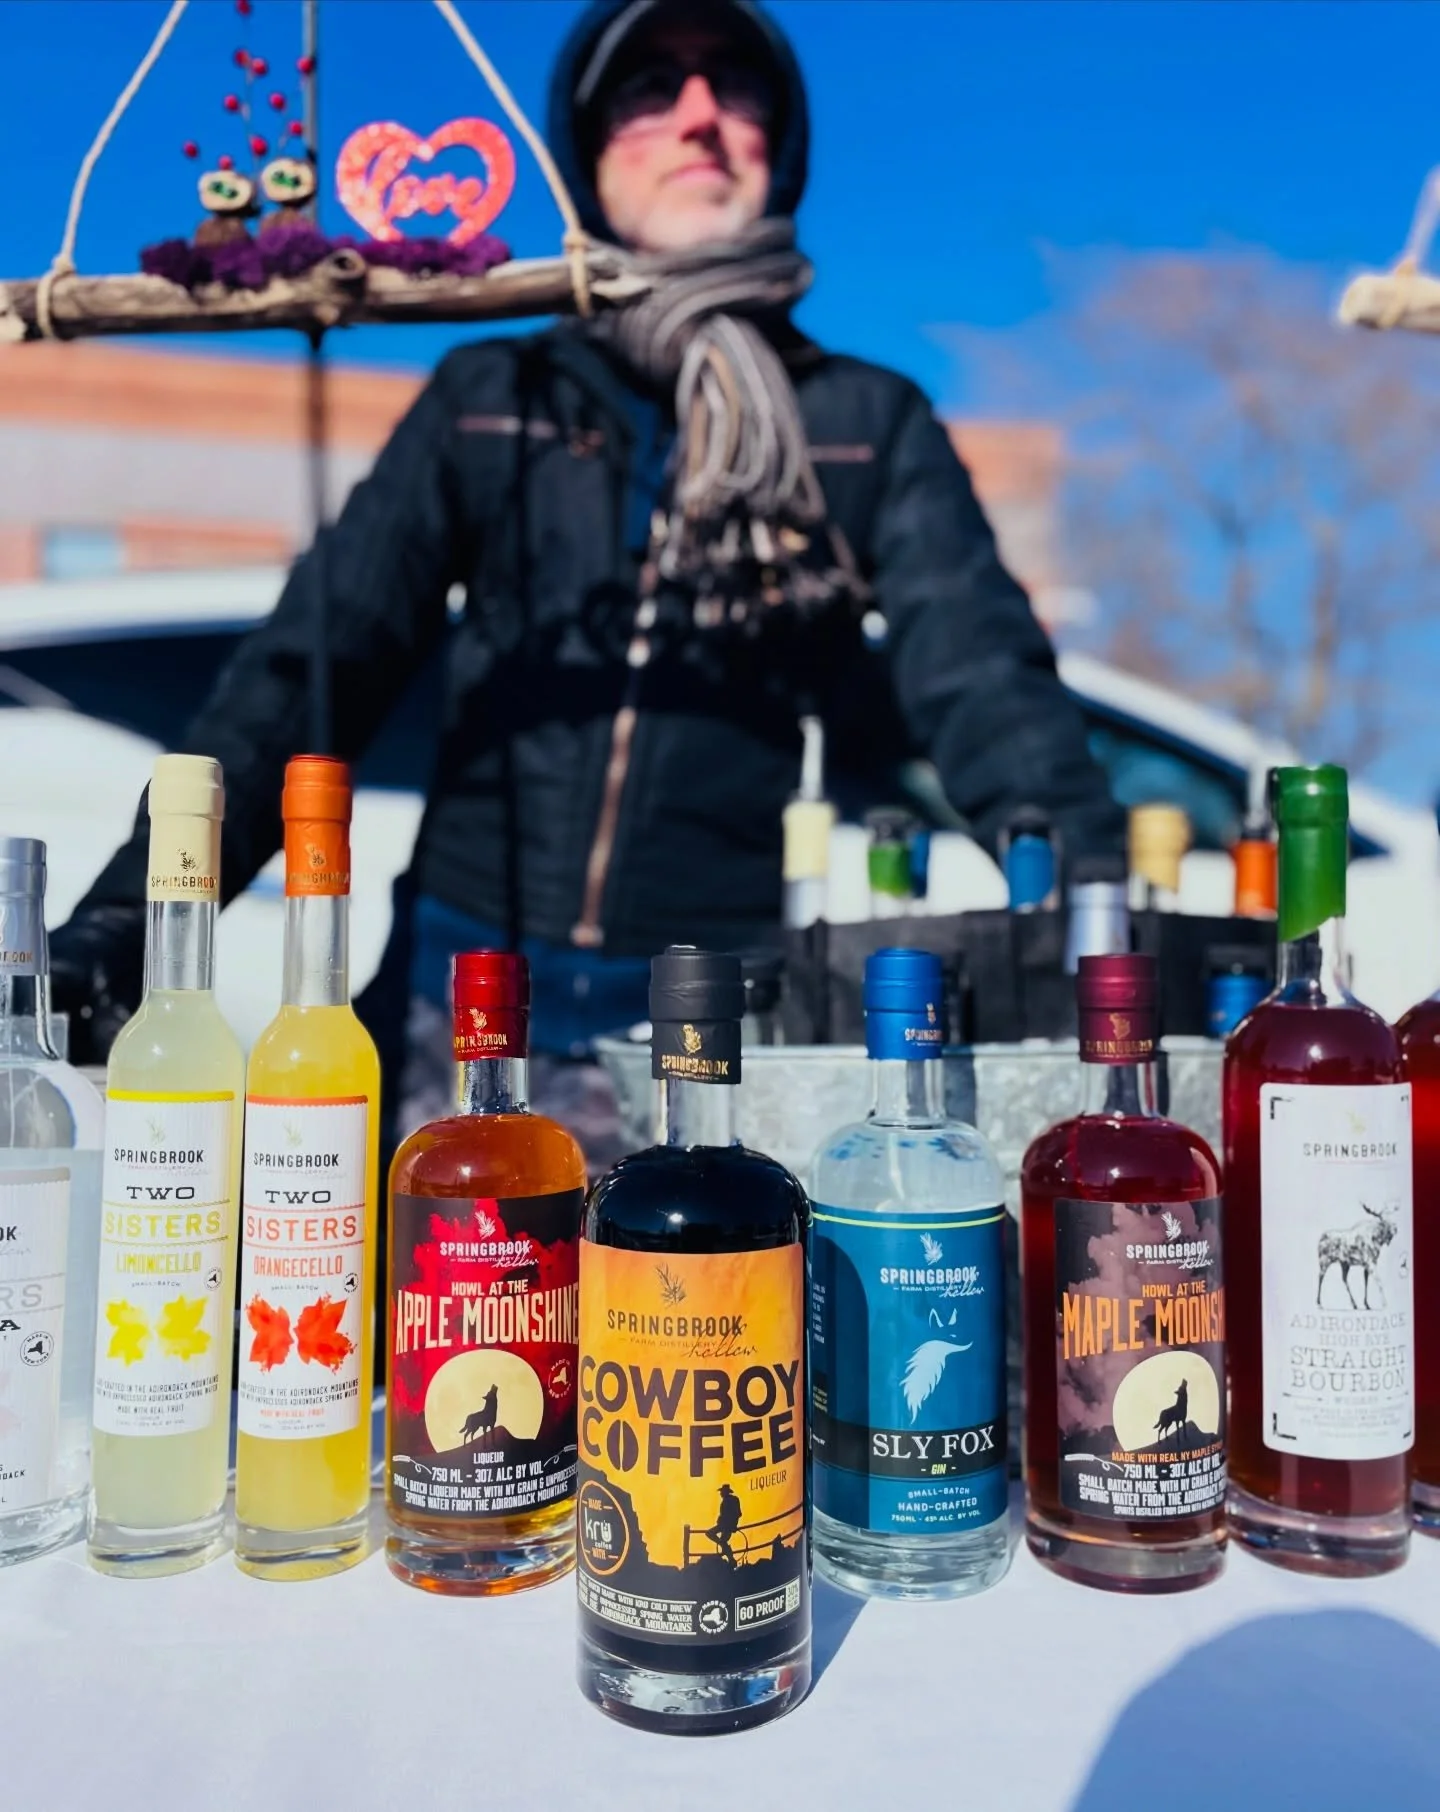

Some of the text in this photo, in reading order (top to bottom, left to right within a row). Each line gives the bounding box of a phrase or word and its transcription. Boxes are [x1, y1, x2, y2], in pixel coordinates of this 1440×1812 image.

[114, 1148, 204, 1164] SPRINGBROOK
[253, 1152, 340, 1168] SPRINGBROOK
[1303, 1142, 1398, 1158] SPRINGBROOK
[126, 1186, 195, 1200] TWO
[265, 1190, 331, 1204] TWO
[104, 1211, 221, 1238] SISTERS
[246, 1215, 357, 1242] SISTERS
[439, 1239, 532, 1257] SPRINGBROOK
[1126, 1239, 1209, 1259] SPRINGBROOK
[116, 1251, 202, 1275] LIMONCELLO
[253, 1254, 343, 1278] ORANGECELLO
[880, 1265, 978, 1285] SPRINGBROOK
[451, 1279, 529, 1297] HOWL AT THE
[1142, 1279, 1206, 1298] HOWL AT THE
[395, 1289, 453, 1356] APPLE
[607, 1308, 744, 1338] SPRINGBROOK
[1062, 1291, 1145, 1360] MAPLE
[1290, 1344, 1407, 1369] STRAIGHT
[149, 1382, 188, 1394] ADIRONDACK
[190, 1374, 219, 1389] MOUNTAINS
[290, 1386, 328, 1397] ADIRONDACK
[330, 1378, 359, 1392] MOUNTAINS
[579, 1355, 800, 1421] COWBOY
[1291, 1366, 1405, 1392] BOURBON
[582, 1405, 798, 1478] COFFEE
[872, 1425, 995, 1459] SLY FOX
[473, 1451, 505, 1465] LIQUEUR
[1111, 1451, 1135, 1463] MADE
[1137, 1453, 1158, 1463] WITH
[1159, 1452, 1180, 1463] REAL
[1180, 1450, 1190, 1461] NY
[1191, 1445, 1211, 1459] MAPLE
[431, 1467, 448, 1482] 750
[449, 1468, 464, 1483] ML
[496, 1465, 513, 1482] ALC
[515, 1464, 527, 1479] BY
[529, 1460, 544, 1476] VOL
[931, 1463, 947, 1475] GIN
[1124, 1464, 1142, 1478] 750
[1144, 1464, 1159, 1479] ML
[1188, 1459, 1202, 1476] ALC
[429, 1484, 459, 1499] LIQUEUR
[460, 1486, 482, 1499] MADE
[484, 1485, 504, 1498] WITH
[505, 1483, 516, 1496] NY
[517, 1479, 538, 1494] GRAIN
[750, 1469, 788, 1491] LIQUEUR
[1078, 1472, 1105, 1490] SMALL
[1107, 1478, 1133, 1492] BATCH
[1135, 1480, 1158, 1493] MADE
[1159, 1480, 1179, 1493] WITH
[1180, 1478, 1190, 1491] NY
[405, 1480, 569, 1512] SPRING WATER FROM THE ADIRONDACK MOUNTAINS
[908, 1487, 970, 1499] SMALL-BATCH
[1079, 1486, 1110, 1504] SPRING
[1111, 1491, 1140, 1507] WATER
[1142, 1493, 1166, 1507] FROM
[1167, 1492, 1183, 1506] THE
[897, 1497, 978, 1512] HAND-CRAFTED
[957, 1512, 967, 1520] BY
[617, 1594, 634, 1607] WITH
[650, 1601, 668, 1612] COLD
[670, 1604, 693, 1613] BREW
[739, 1605, 754, 1621] 60
[755, 1594, 785, 1618] PROOF
[600, 1605, 693, 1632] ADIRONDACK MOUNTAINS
[639, 1608, 664, 1622] SPRING
[666, 1613, 693, 1623] WATER
